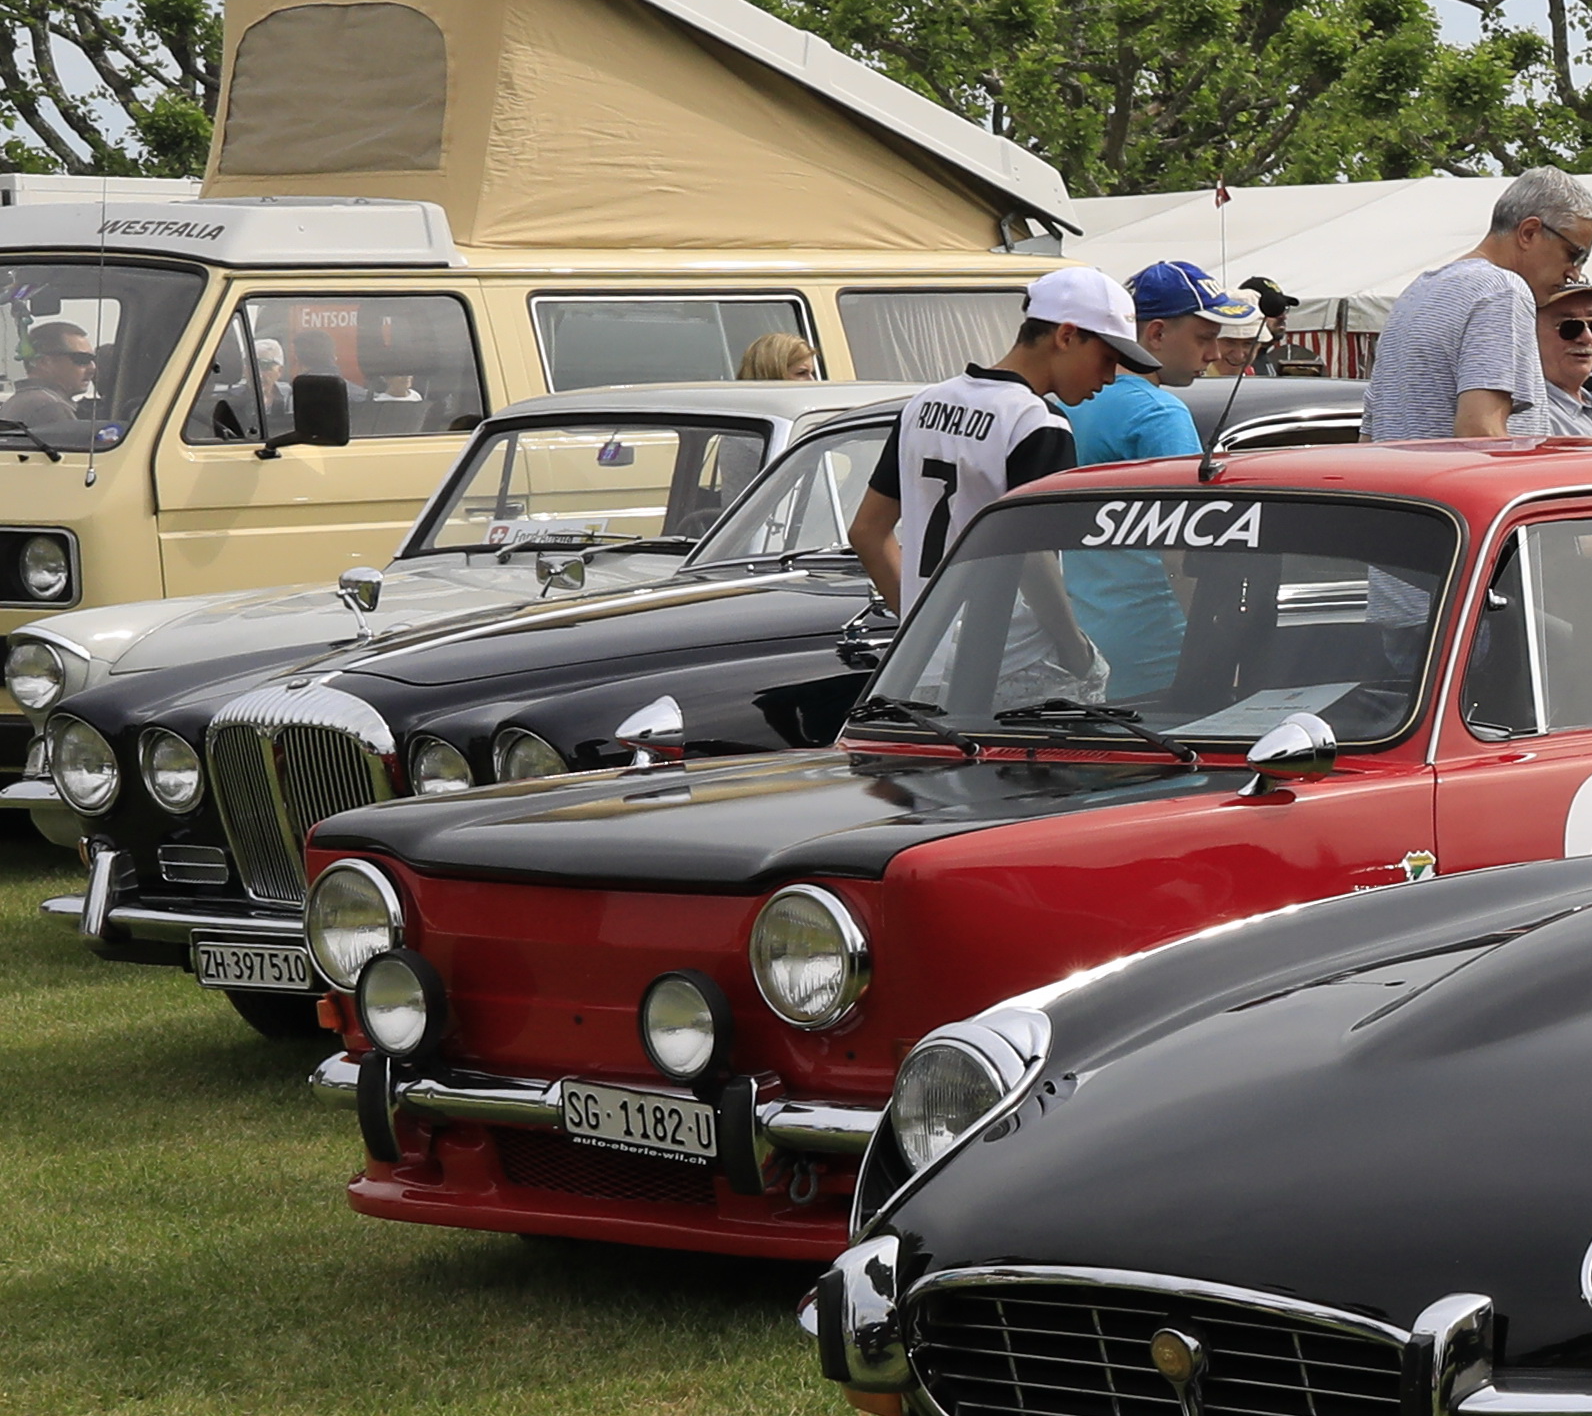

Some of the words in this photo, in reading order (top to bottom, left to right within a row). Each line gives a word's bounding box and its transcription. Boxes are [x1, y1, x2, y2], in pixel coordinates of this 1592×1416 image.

[97, 219, 226, 241] WESTFALIA
[918, 457, 958, 578] 7
[1081, 500, 1262, 548] SIMCA
[572, 1135, 708, 1166] auto-eberle-wil.ch
